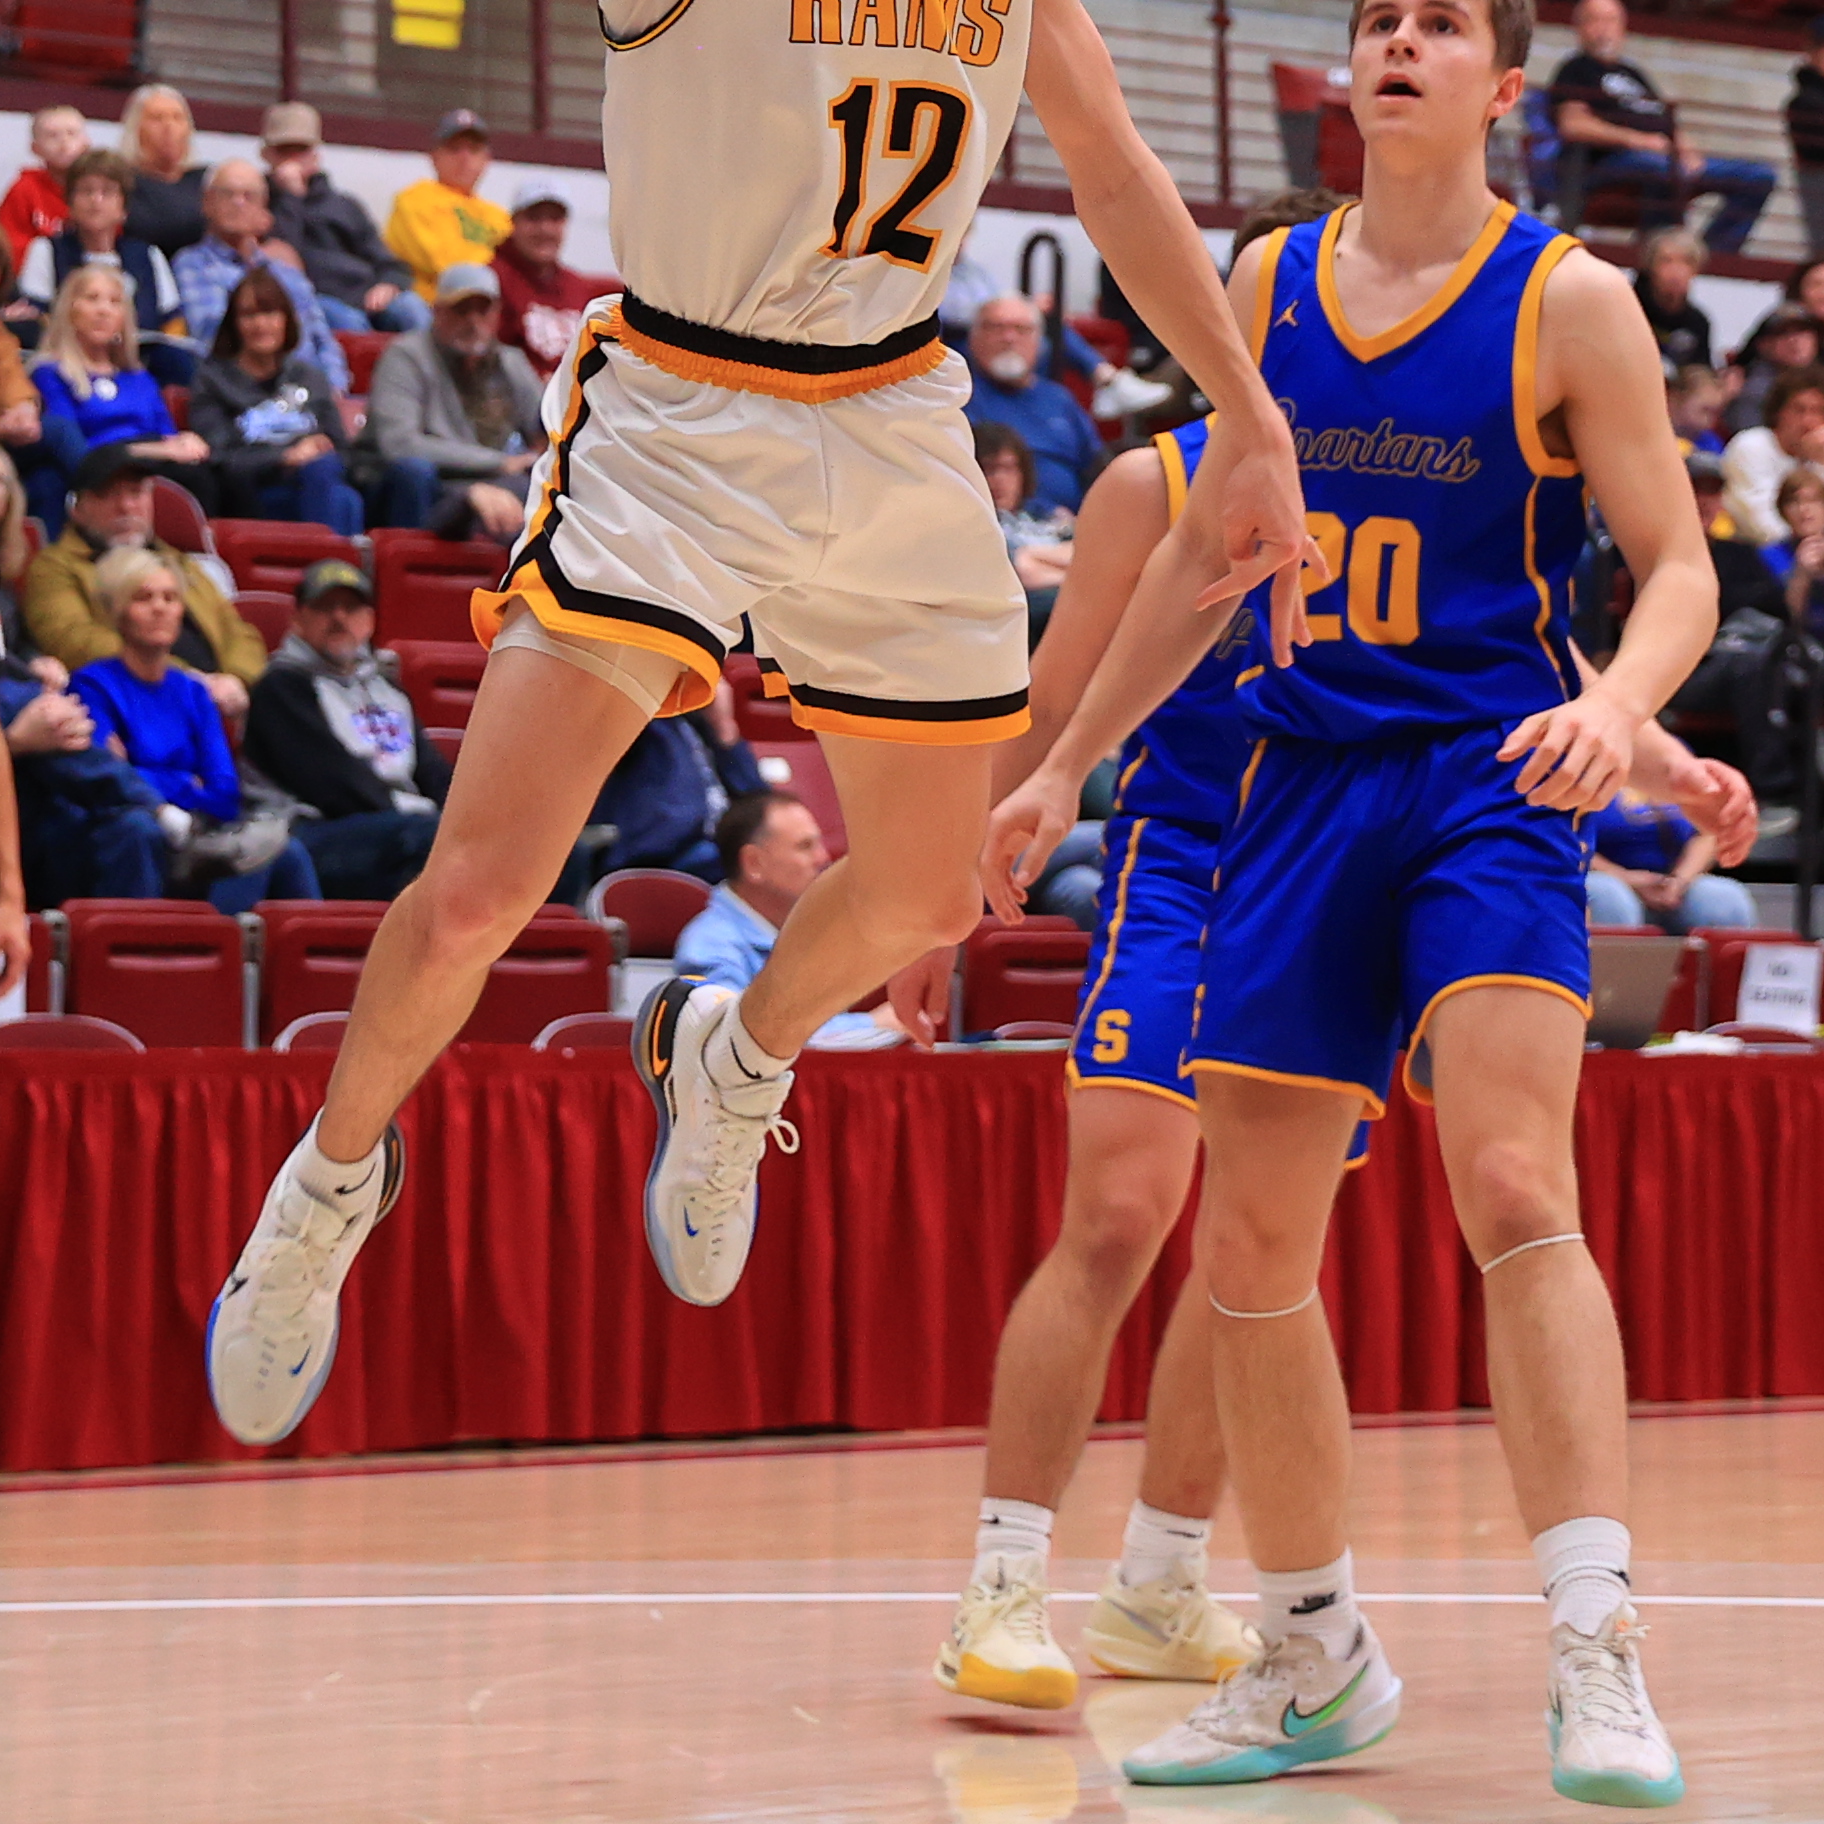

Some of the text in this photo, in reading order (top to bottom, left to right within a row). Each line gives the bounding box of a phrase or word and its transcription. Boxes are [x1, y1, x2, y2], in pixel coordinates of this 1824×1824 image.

[815, 78, 973, 274] 12
[1290, 510, 1422, 647] 20
[1091, 1008, 1132, 1065] S
